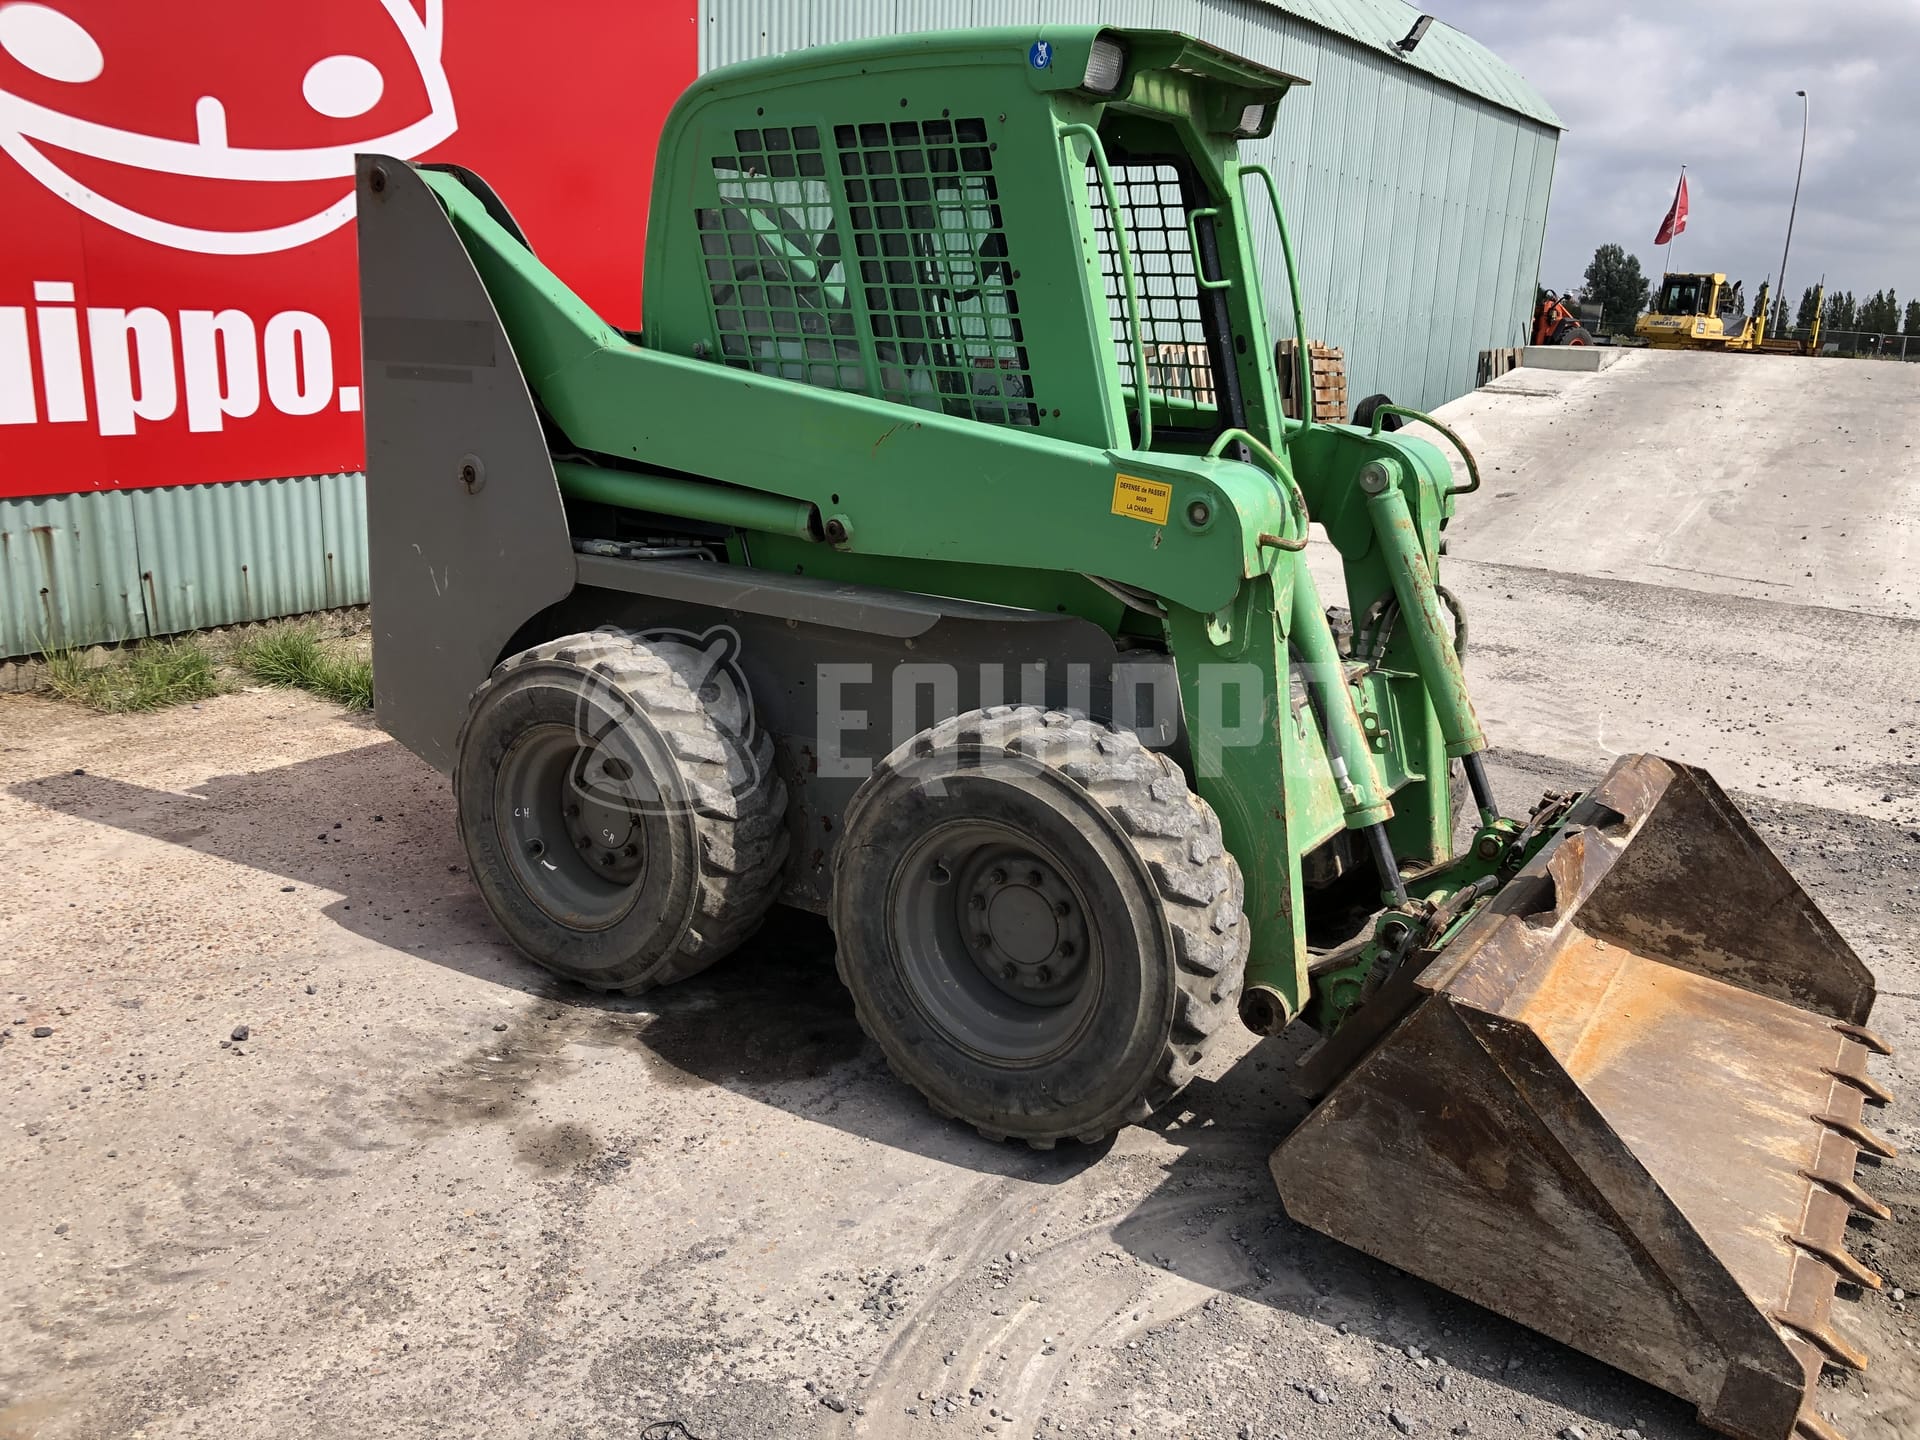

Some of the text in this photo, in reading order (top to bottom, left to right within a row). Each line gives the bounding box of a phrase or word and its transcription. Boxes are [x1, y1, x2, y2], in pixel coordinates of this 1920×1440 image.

[1120, 482, 1141, 492] DEFENSE
[1148, 488, 1166, 497] PASSER
[1134, 505, 1153, 515] CHARGE
